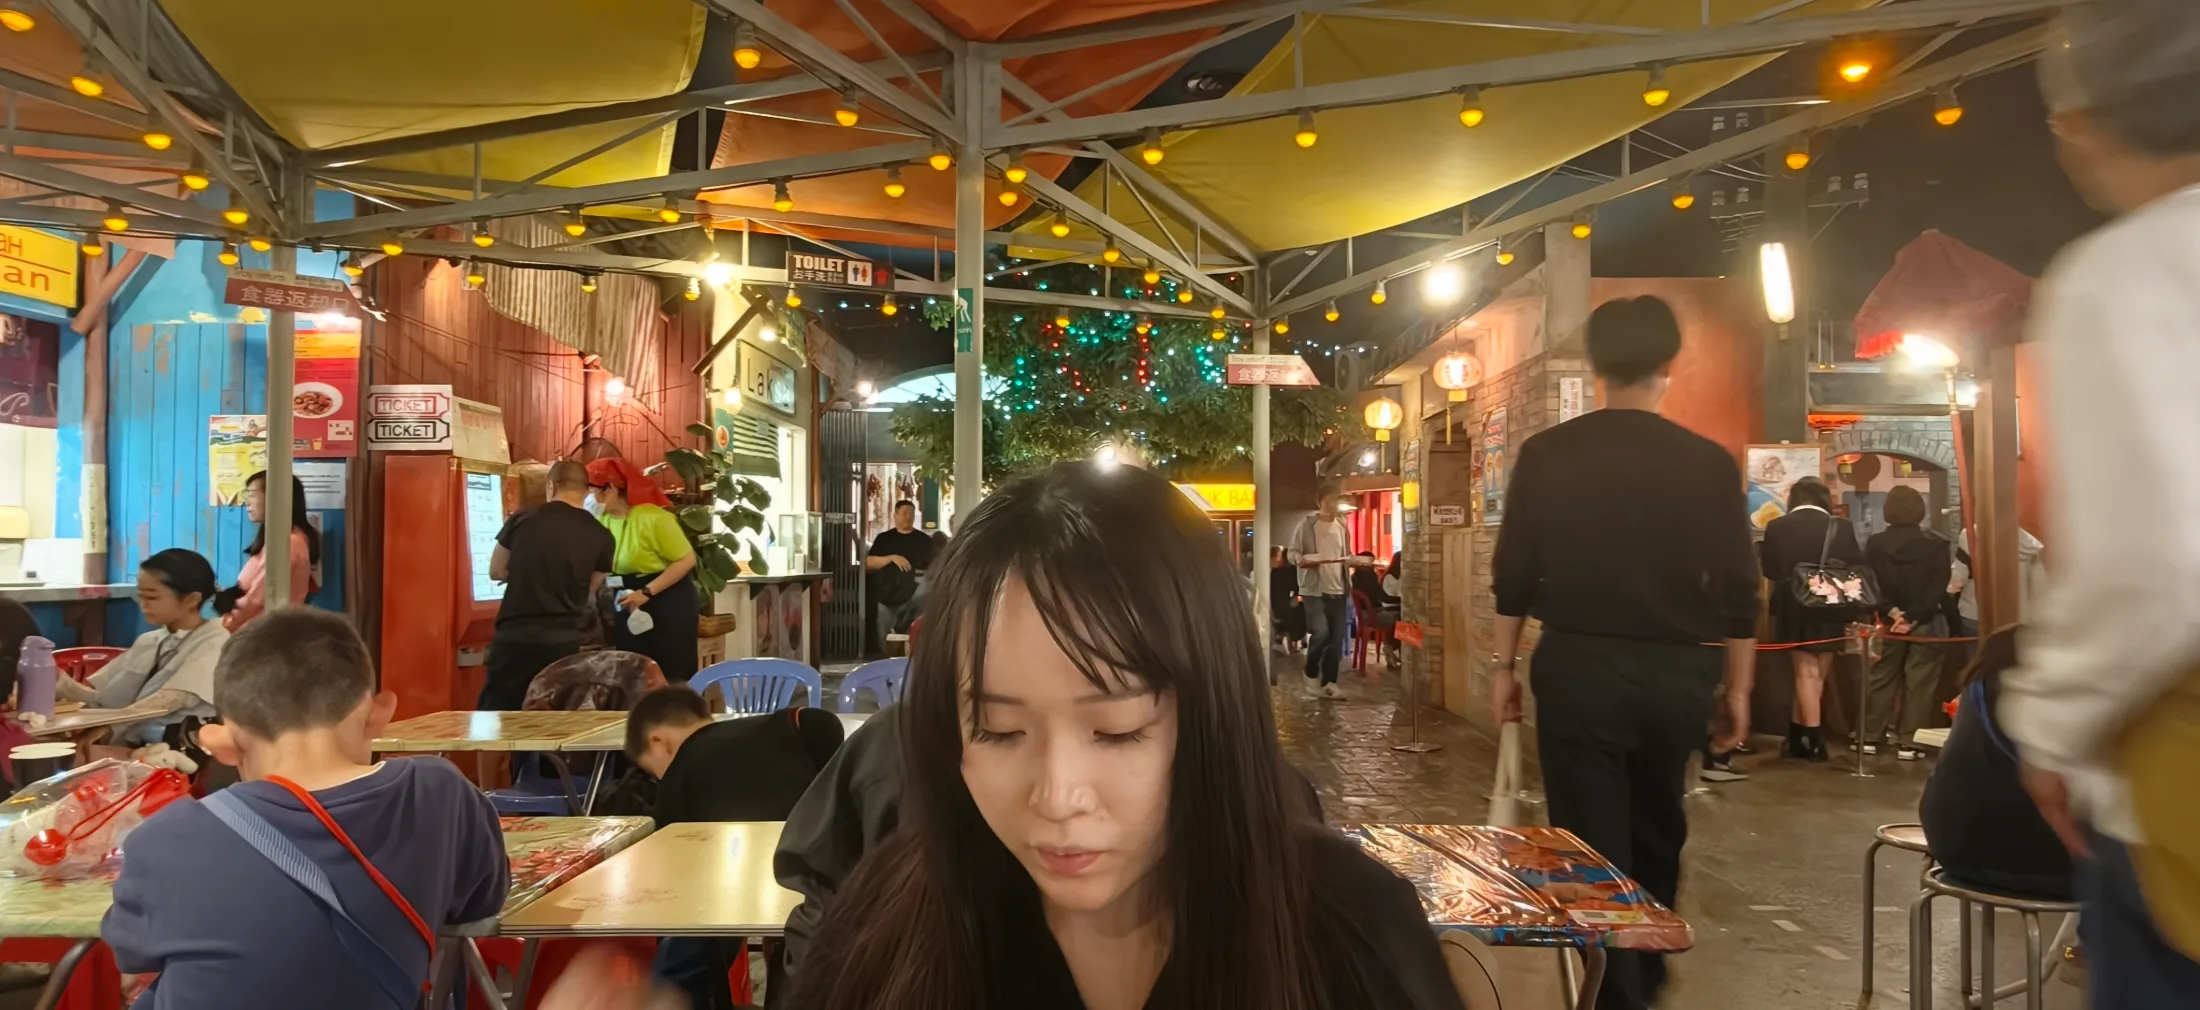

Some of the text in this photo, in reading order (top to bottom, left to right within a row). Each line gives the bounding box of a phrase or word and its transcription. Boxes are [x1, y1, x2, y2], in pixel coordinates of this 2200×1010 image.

[793, 255, 845, 272] TOILET
[379, 399, 432, 412] TICKET
[379, 424, 432, 437] TICKET
